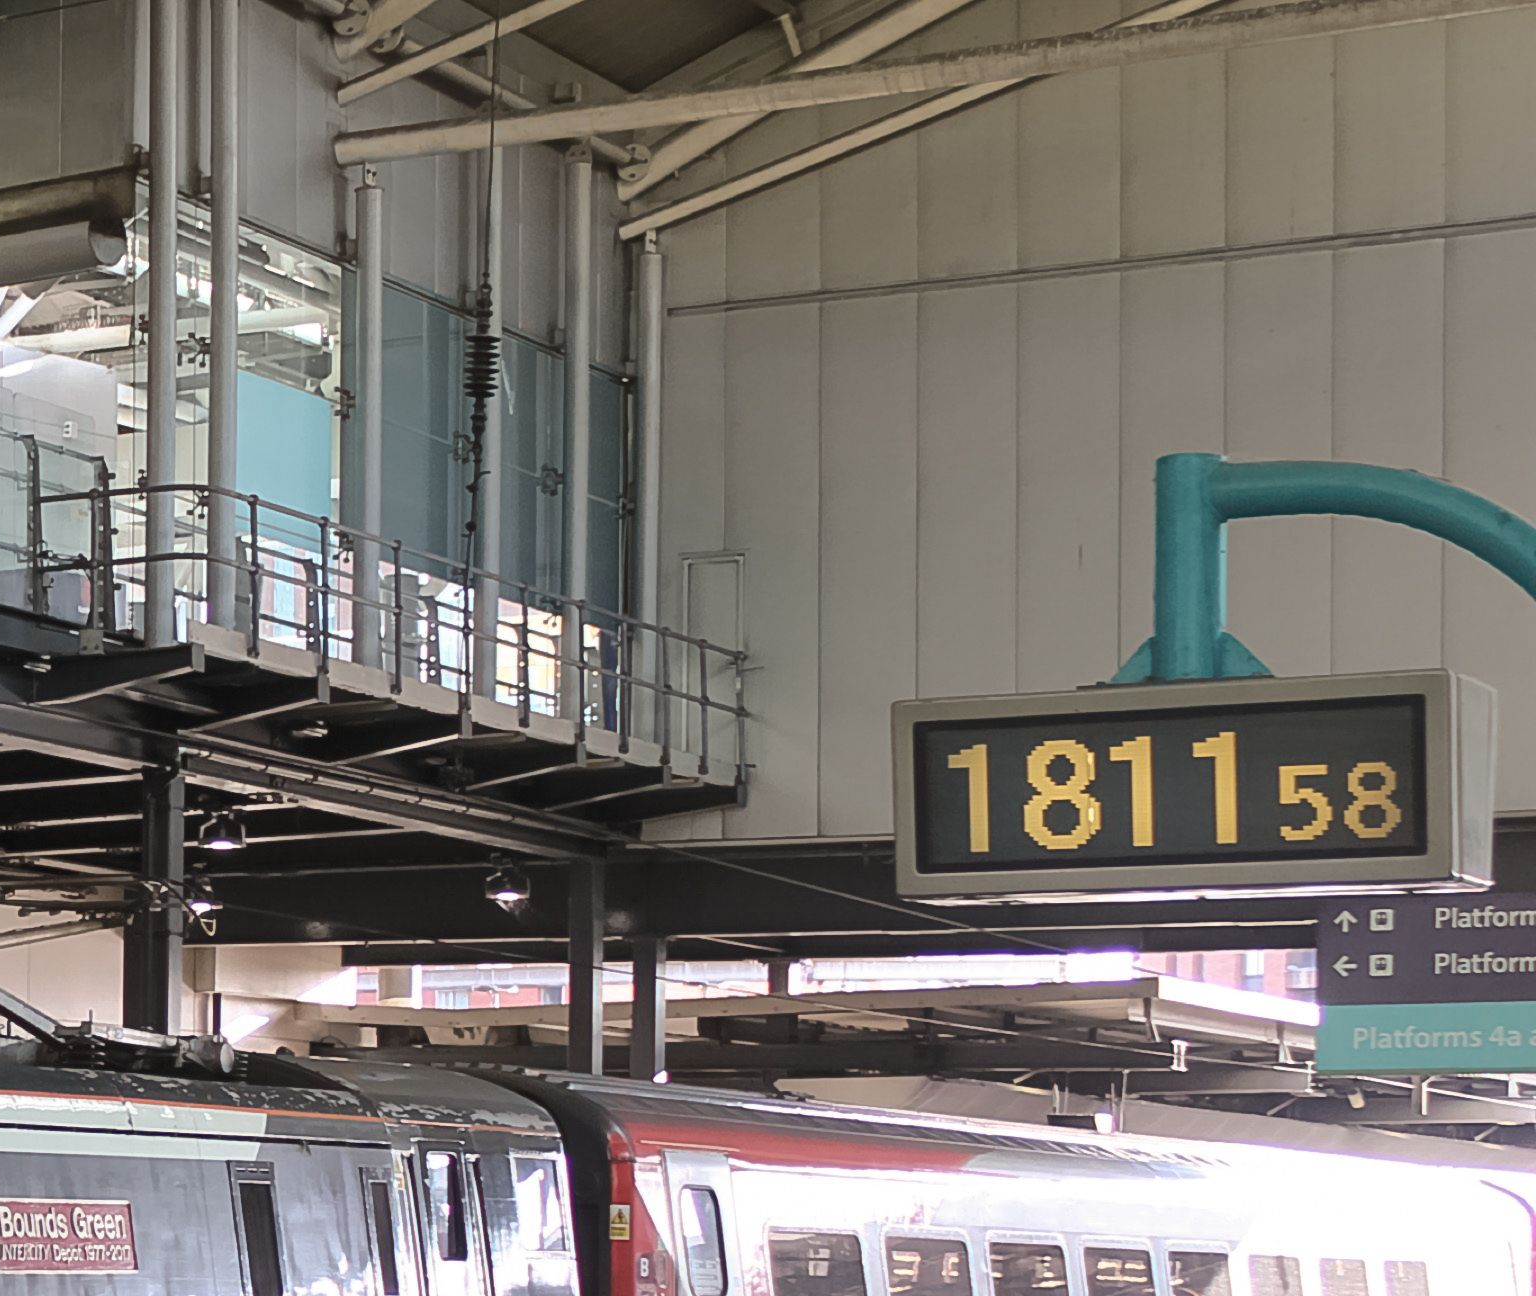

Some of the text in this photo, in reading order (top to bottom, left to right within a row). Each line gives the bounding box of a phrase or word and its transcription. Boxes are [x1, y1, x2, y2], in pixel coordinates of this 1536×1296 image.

[947, 731, 1402, 853] 1811 58
[1353, 1026, 1482, 1050] Platforms
[1489, 1026, 1521, 1048] 4a
[72, 1206, 127, 1240] Green
[1, 1243, 51, 1262] INTERCITY
[52, 1244, 83, 1264] Depot
